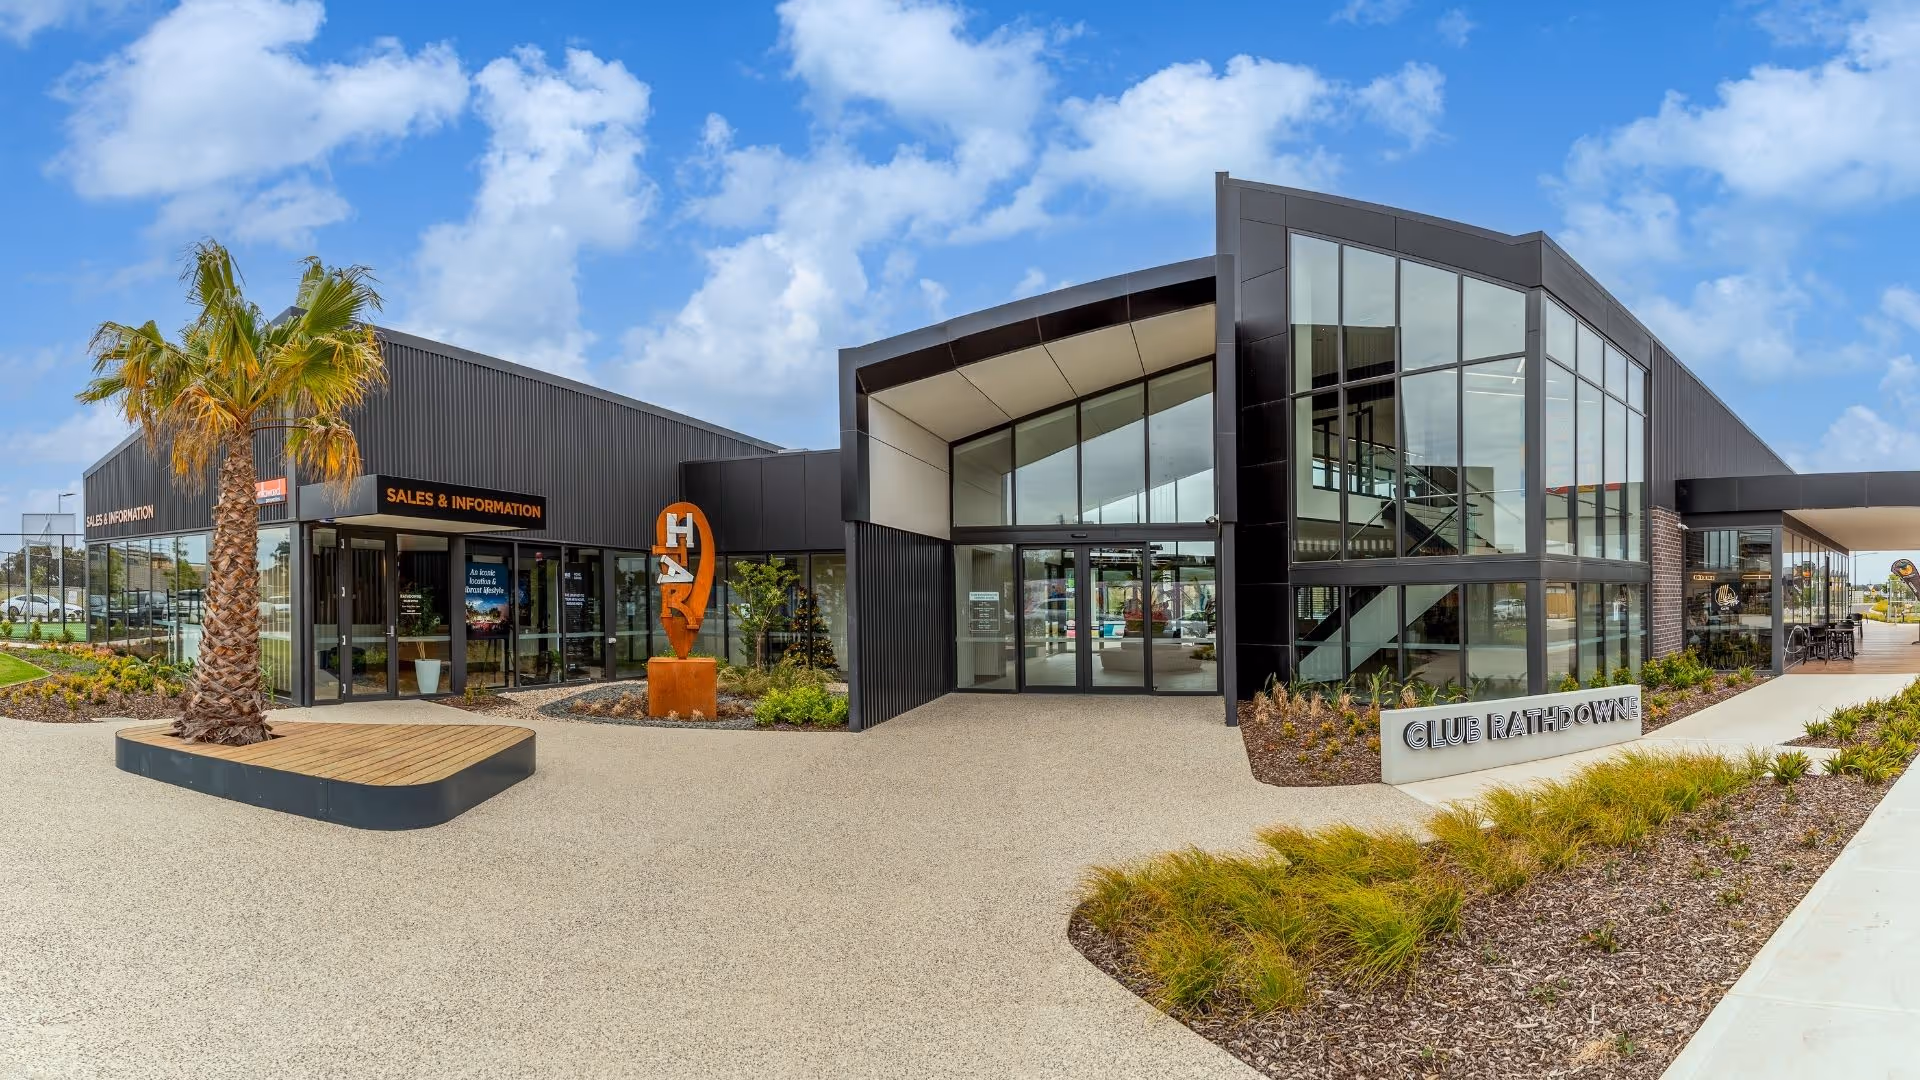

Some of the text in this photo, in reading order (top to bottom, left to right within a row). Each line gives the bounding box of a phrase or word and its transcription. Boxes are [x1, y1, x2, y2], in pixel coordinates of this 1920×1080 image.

[386, 487, 541, 518] SALES & INFORMATION
[86, 504, 154, 528] SALES & INFORMATION
[469, 568, 496, 577] An iconic
[469, 577, 491, 585] location
[483, 586, 504, 596] lifestyle
[1403, 696, 1639, 750] CLUB RATHDOWNE
